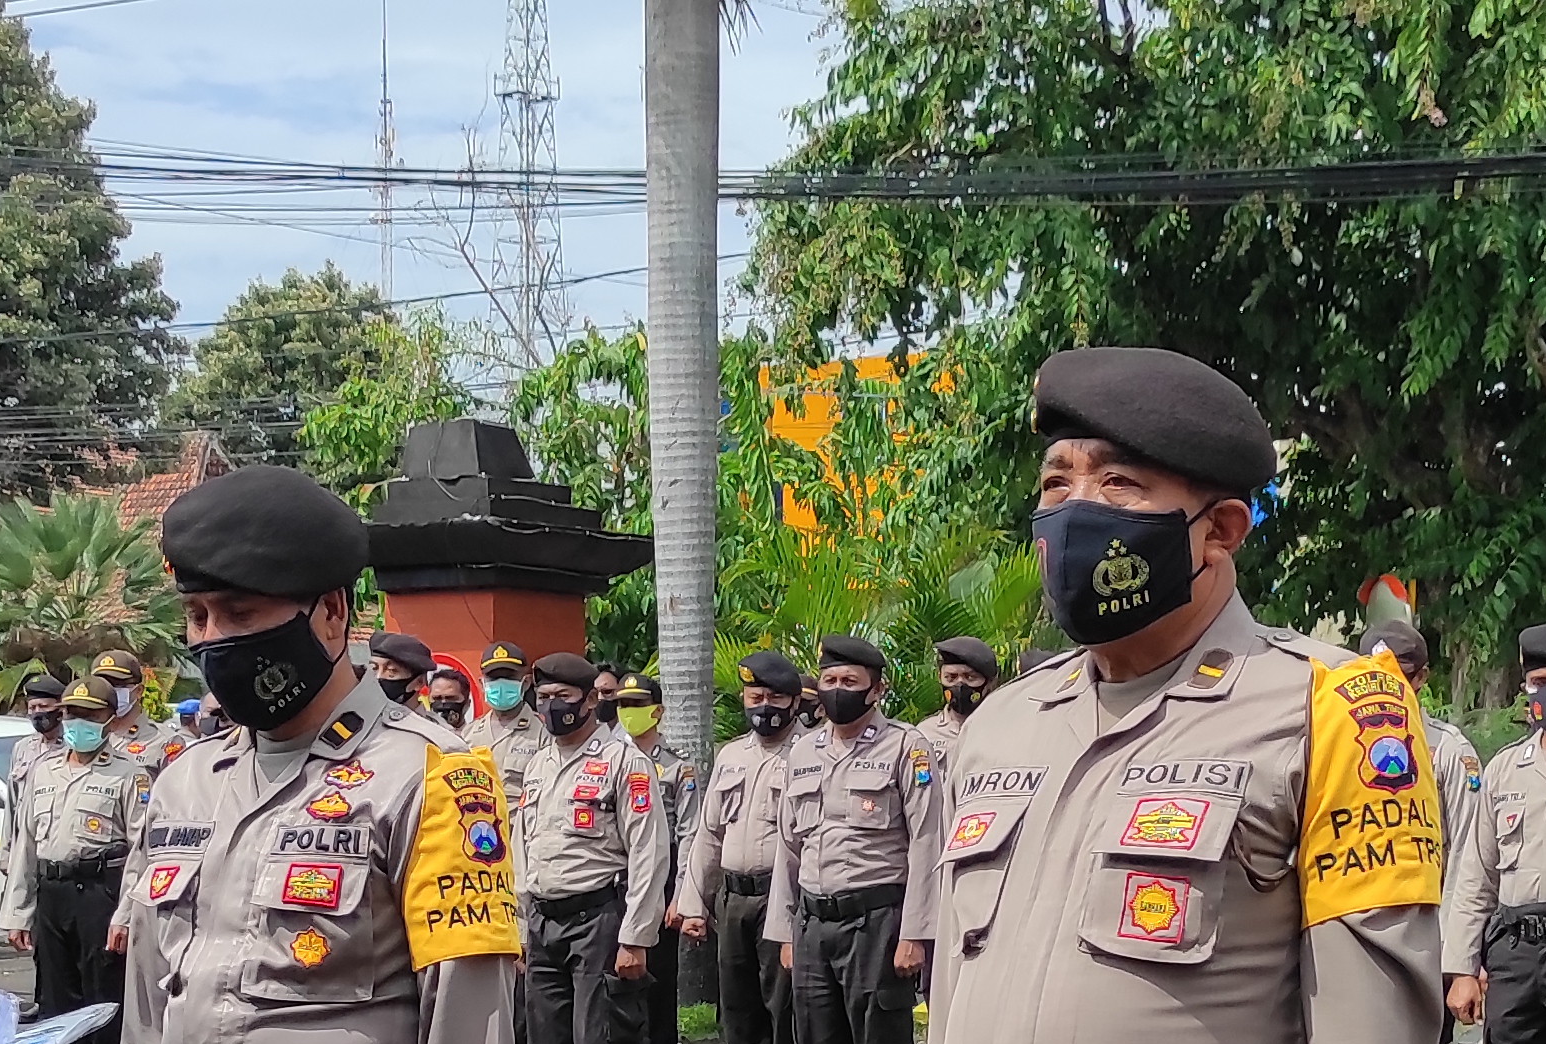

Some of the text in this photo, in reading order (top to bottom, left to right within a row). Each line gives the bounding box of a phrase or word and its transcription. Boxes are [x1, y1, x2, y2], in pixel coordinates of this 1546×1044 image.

[1097, 595, 1151, 616] POLRI
[268, 681, 307, 714] POLRI
[960, 771, 1042, 798] IMRON
[1121, 763, 1245, 790] POLISI
[1332, 798, 1434, 839] PADAL
[279, 826, 360, 853] POLRI
[1315, 844, 1396, 881] PAM
[437, 873, 515, 898] PADAL
[426, 907, 490, 933] PAM
